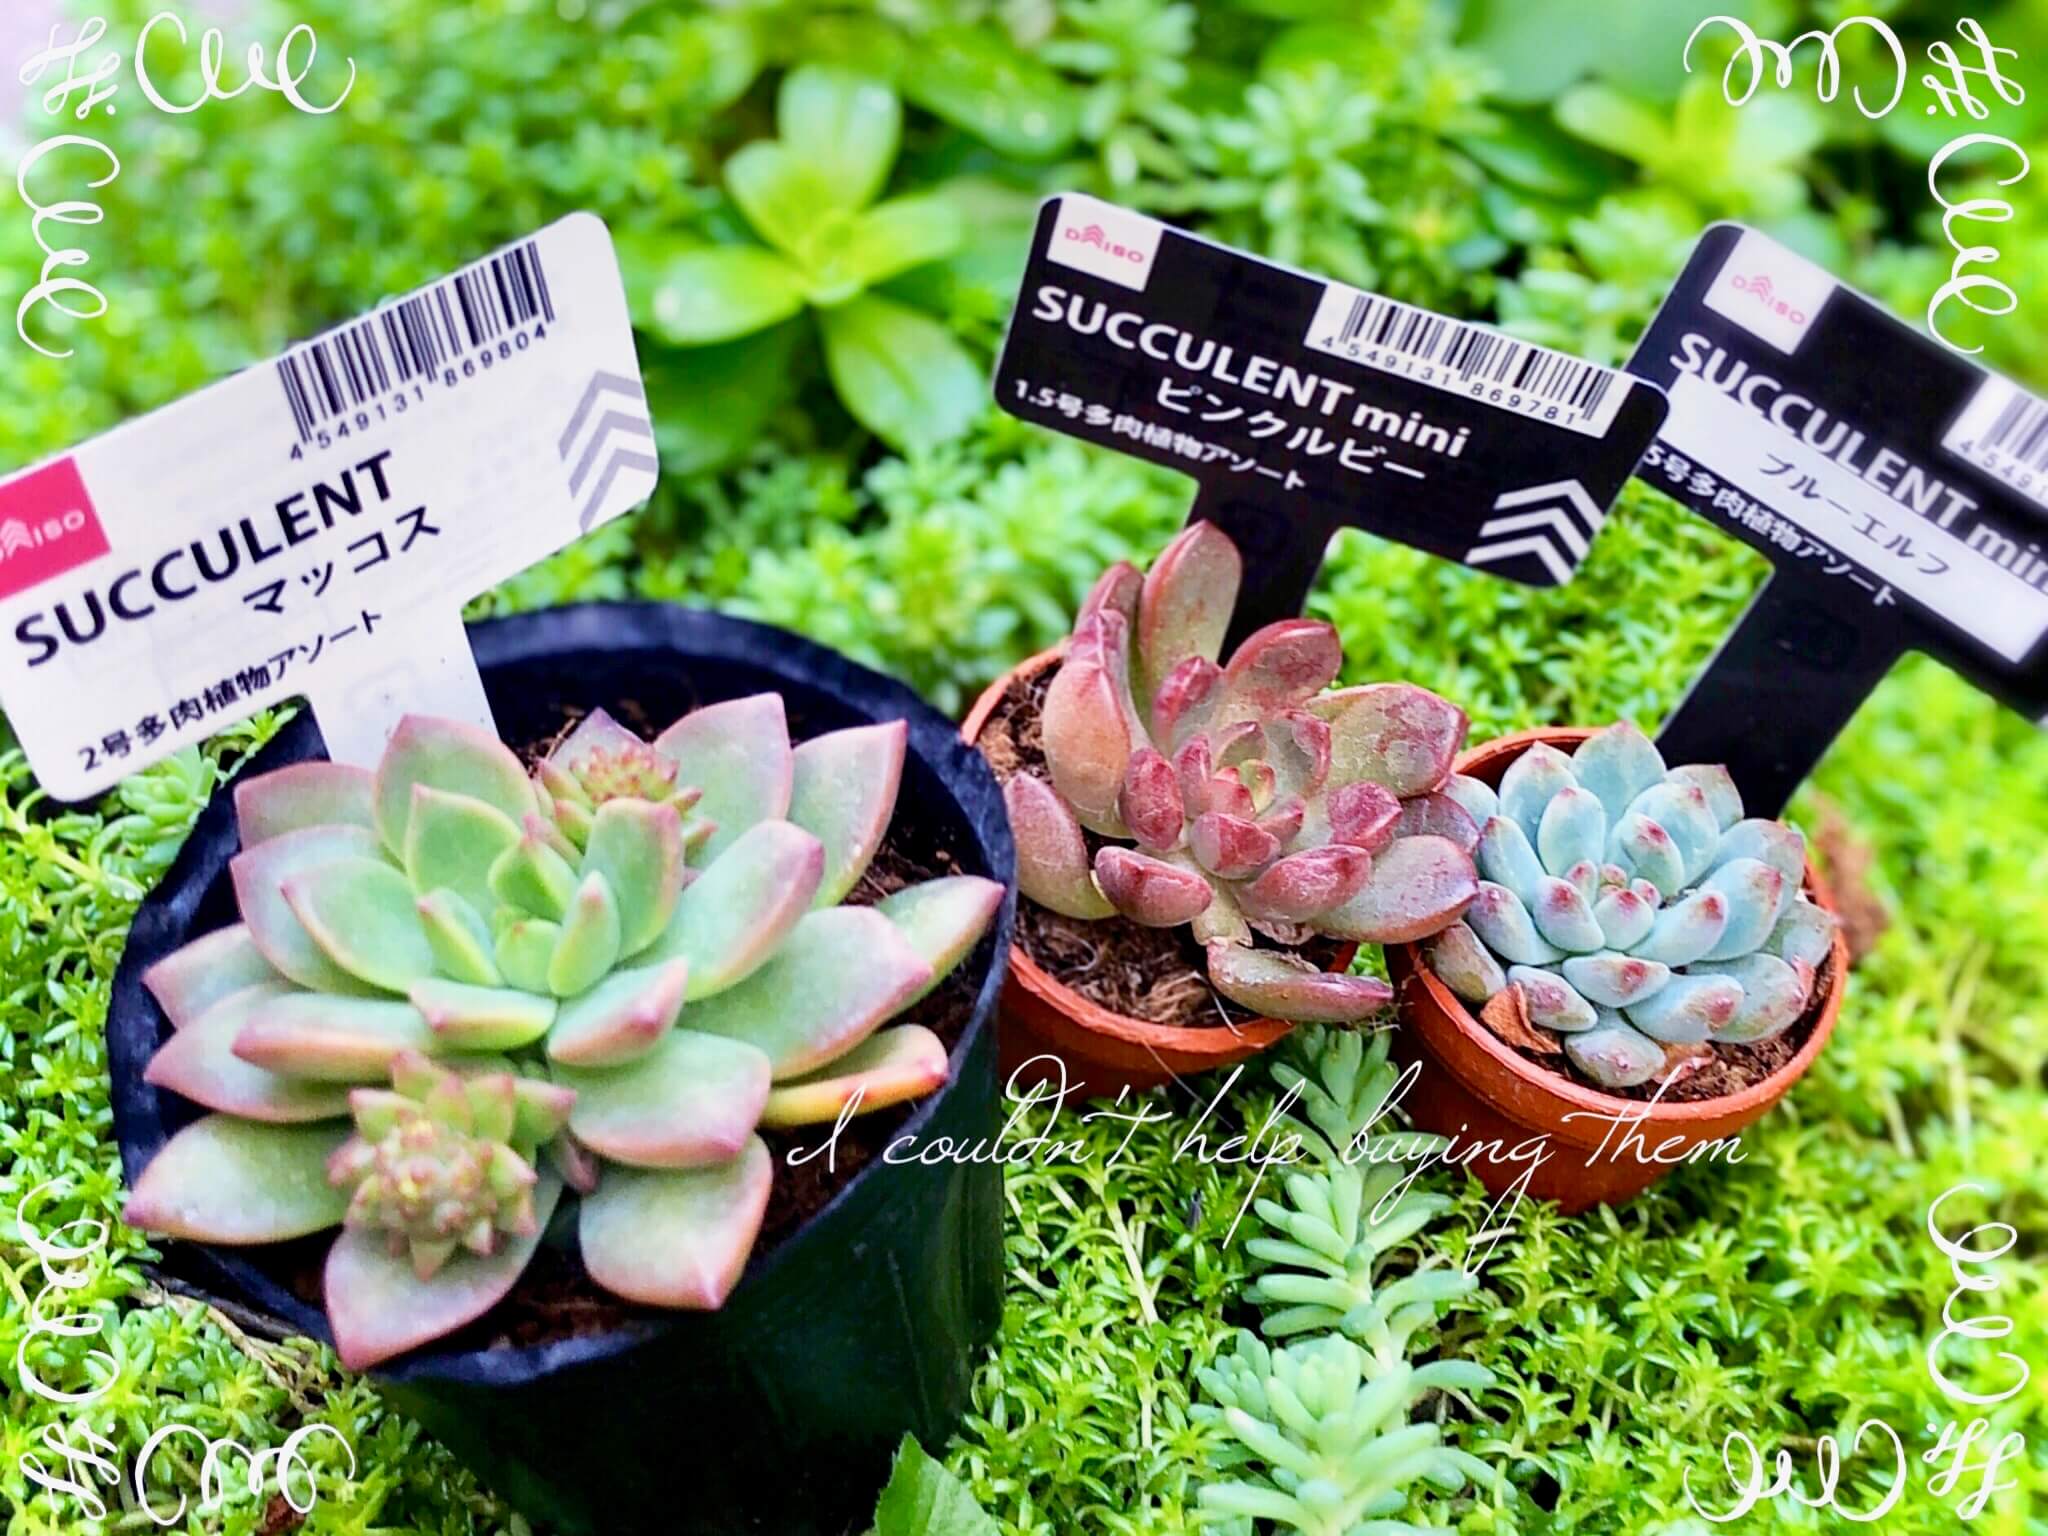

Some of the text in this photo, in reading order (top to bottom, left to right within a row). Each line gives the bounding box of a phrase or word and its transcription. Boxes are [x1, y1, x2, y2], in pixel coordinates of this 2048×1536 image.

[1064, 224, 1145, 263] DAISO
[1032, 285, 1472, 458] SUCCULENT mini
[1015, 379, 1306, 490] 1.5号多肉植物アソート
[1157, 377, 1426, 480] ピンクルビー
[1669, 333, 1979, 530] SUCCULENT
[0, 508, 86, 563] AISO
[15, 449, 392, 667] SUCCULENT
[243, 505, 441, 614] マッコス
[78, 610, 382, 772] 2号多肉植物アソート
